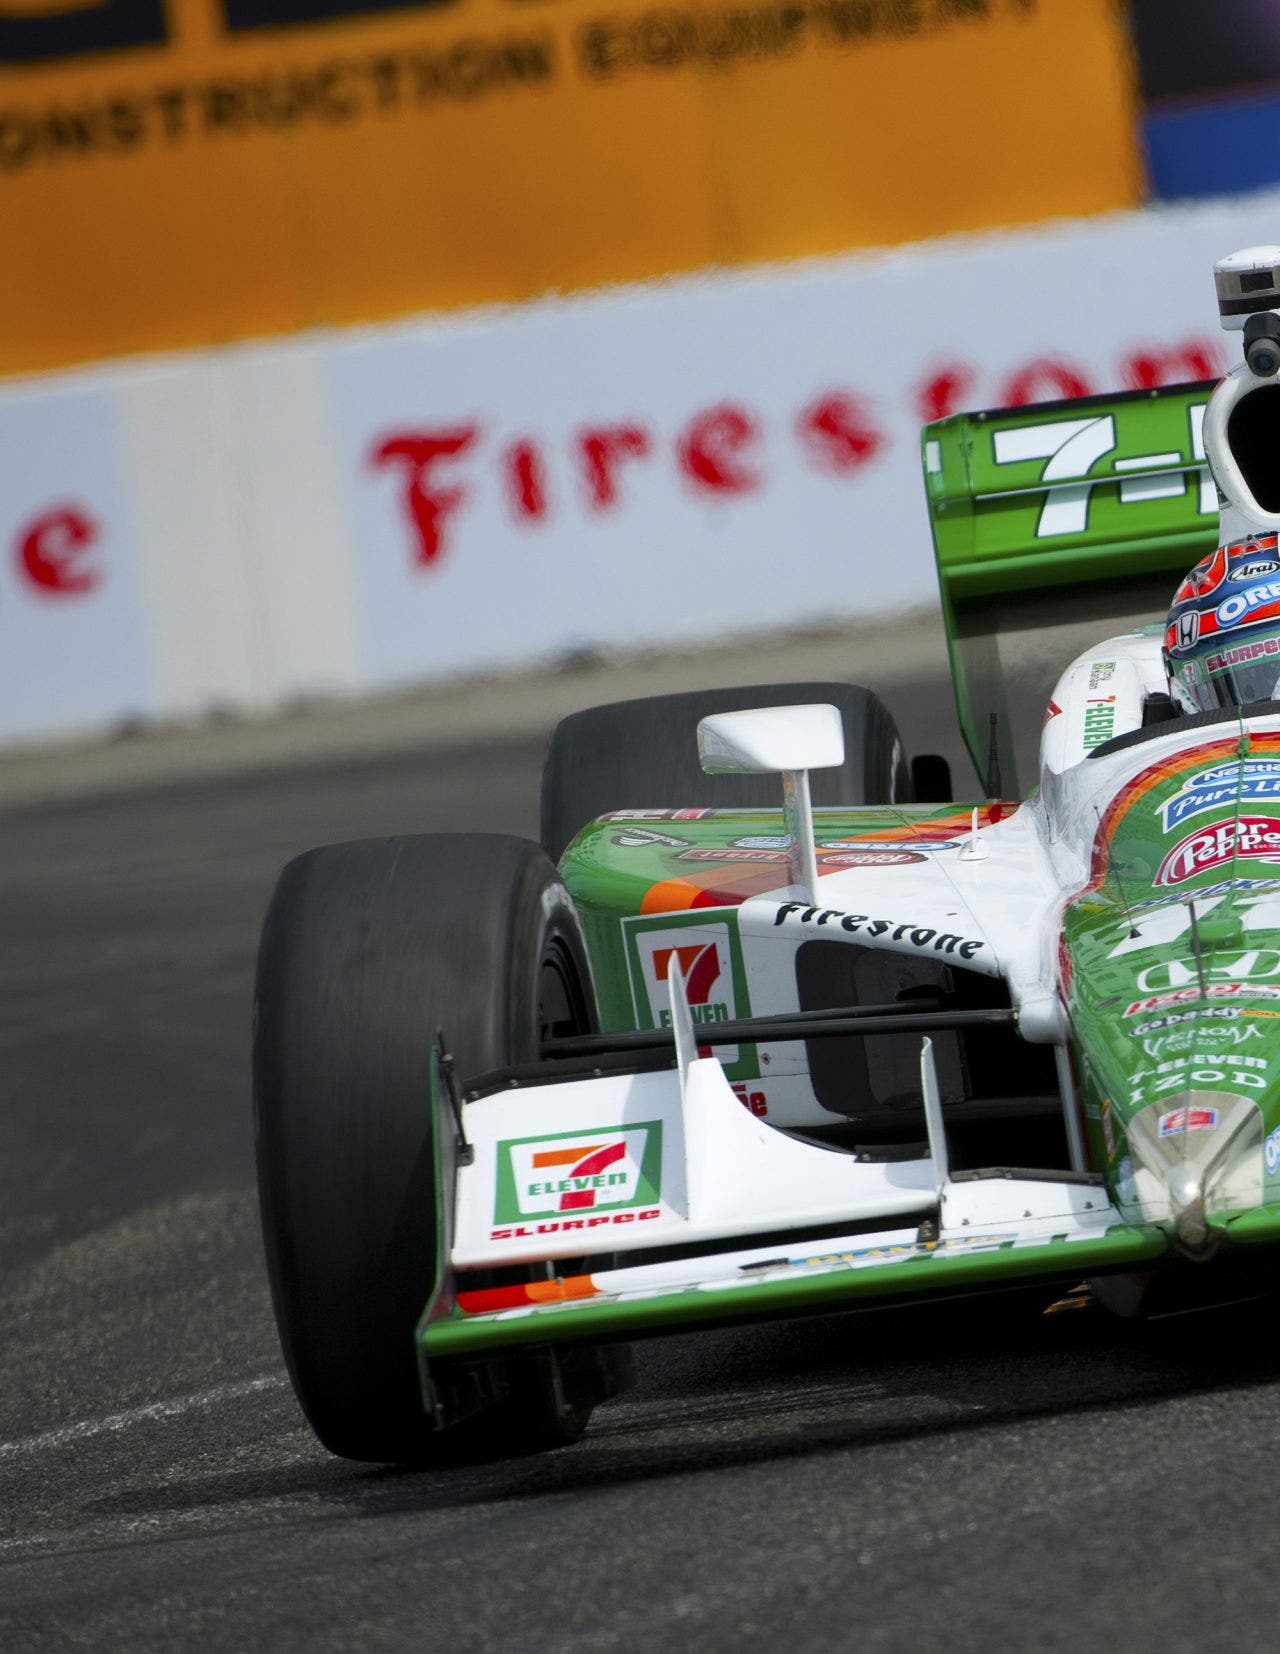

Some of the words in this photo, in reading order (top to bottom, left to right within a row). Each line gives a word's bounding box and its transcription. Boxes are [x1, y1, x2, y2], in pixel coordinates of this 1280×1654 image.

[1236, 560, 1276, 578] Arai
[1173, 783, 1251, 818] Pure
[1216, 821, 1269, 843] Dr
[774, 900, 985, 959] Firestone
[1129, 1070, 1267, 1106] IZOD
